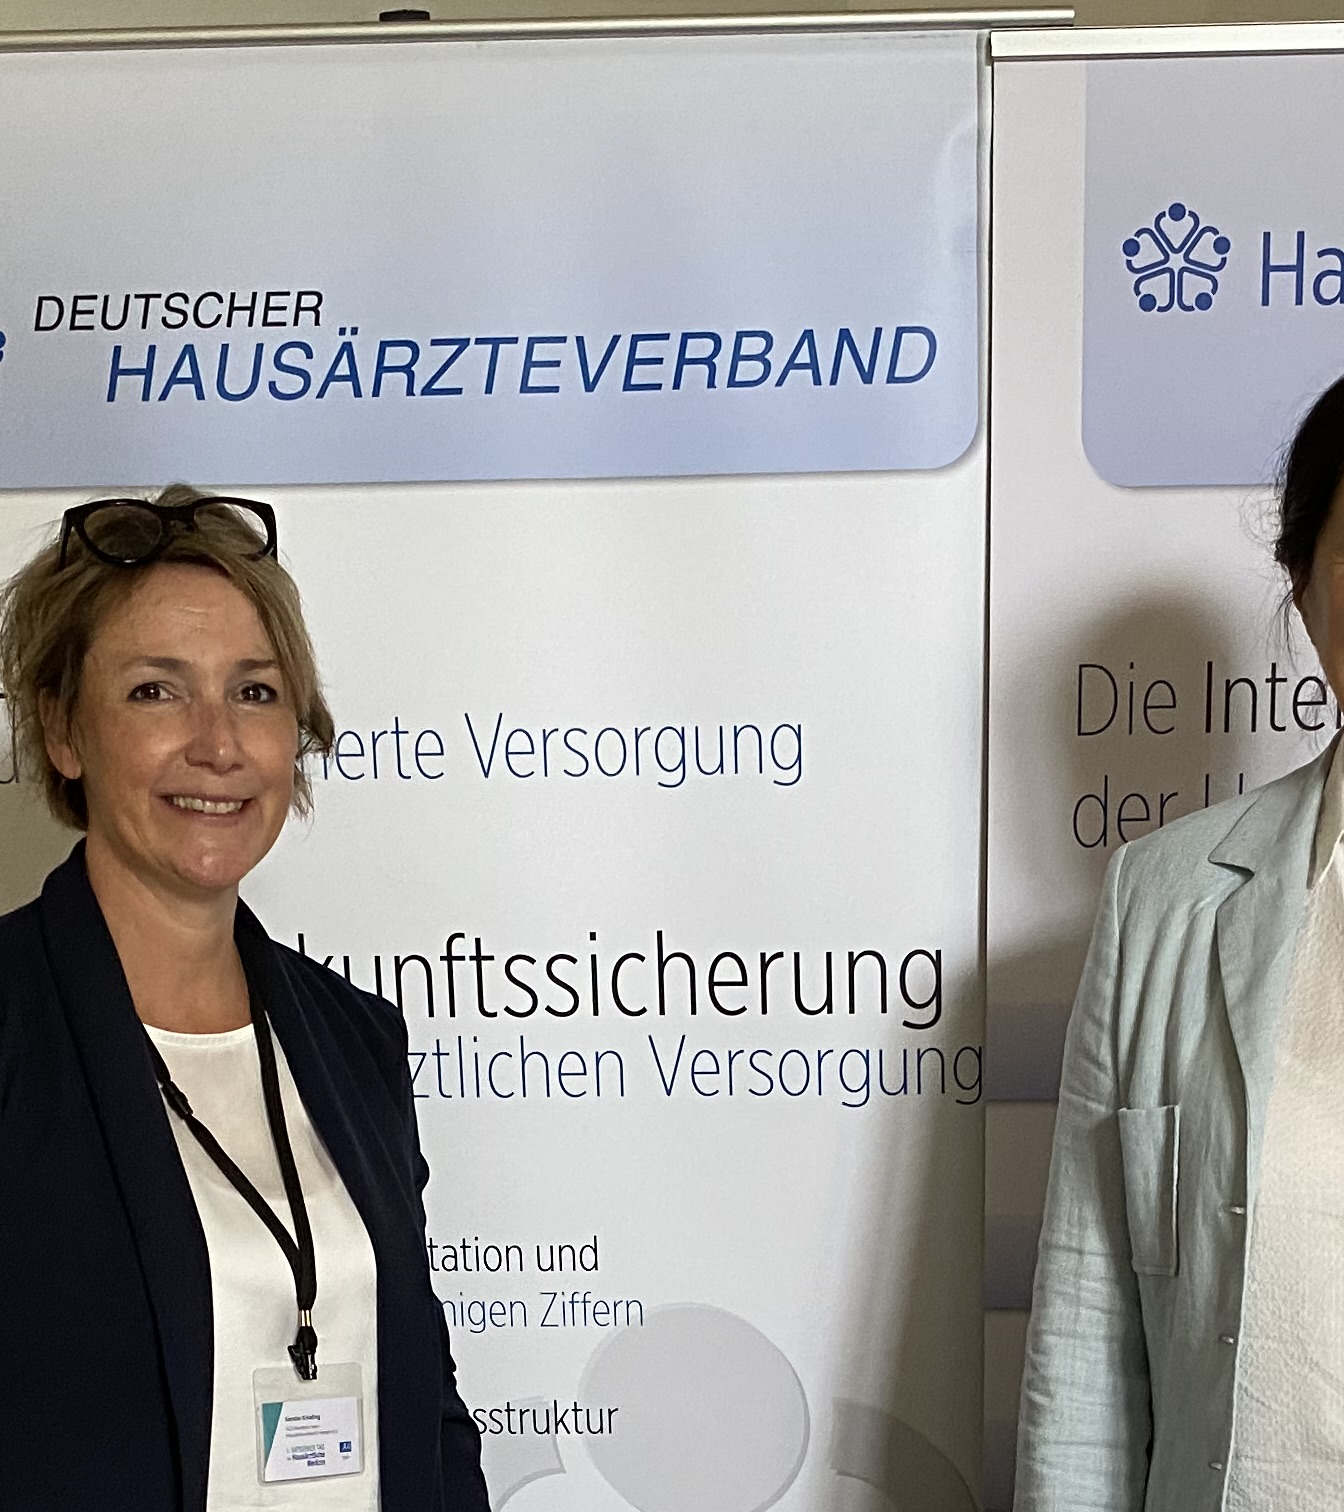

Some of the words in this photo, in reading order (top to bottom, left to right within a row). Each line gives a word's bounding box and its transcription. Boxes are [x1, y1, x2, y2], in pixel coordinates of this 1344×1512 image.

[33, 290, 324, 334] DEUTSCHER
[105, 325, 940, 404] HAUSÄRZTEVERBAND
[1077, 661, 1178, 737] Die
[464, 712, 805, 787] Versorgung
[1072, 774, 1179, 849] der
[406, 1036, 626, 1100] ztlichen
[649, 1034, 986, 1106] Versorgung
[429, 1235, 525, 1273] tation
[536, 1235, 599, 1272] und
[539, 1291, 645, 1329] Ziffern
[474, 1399, 619, 1436] sstruktur
